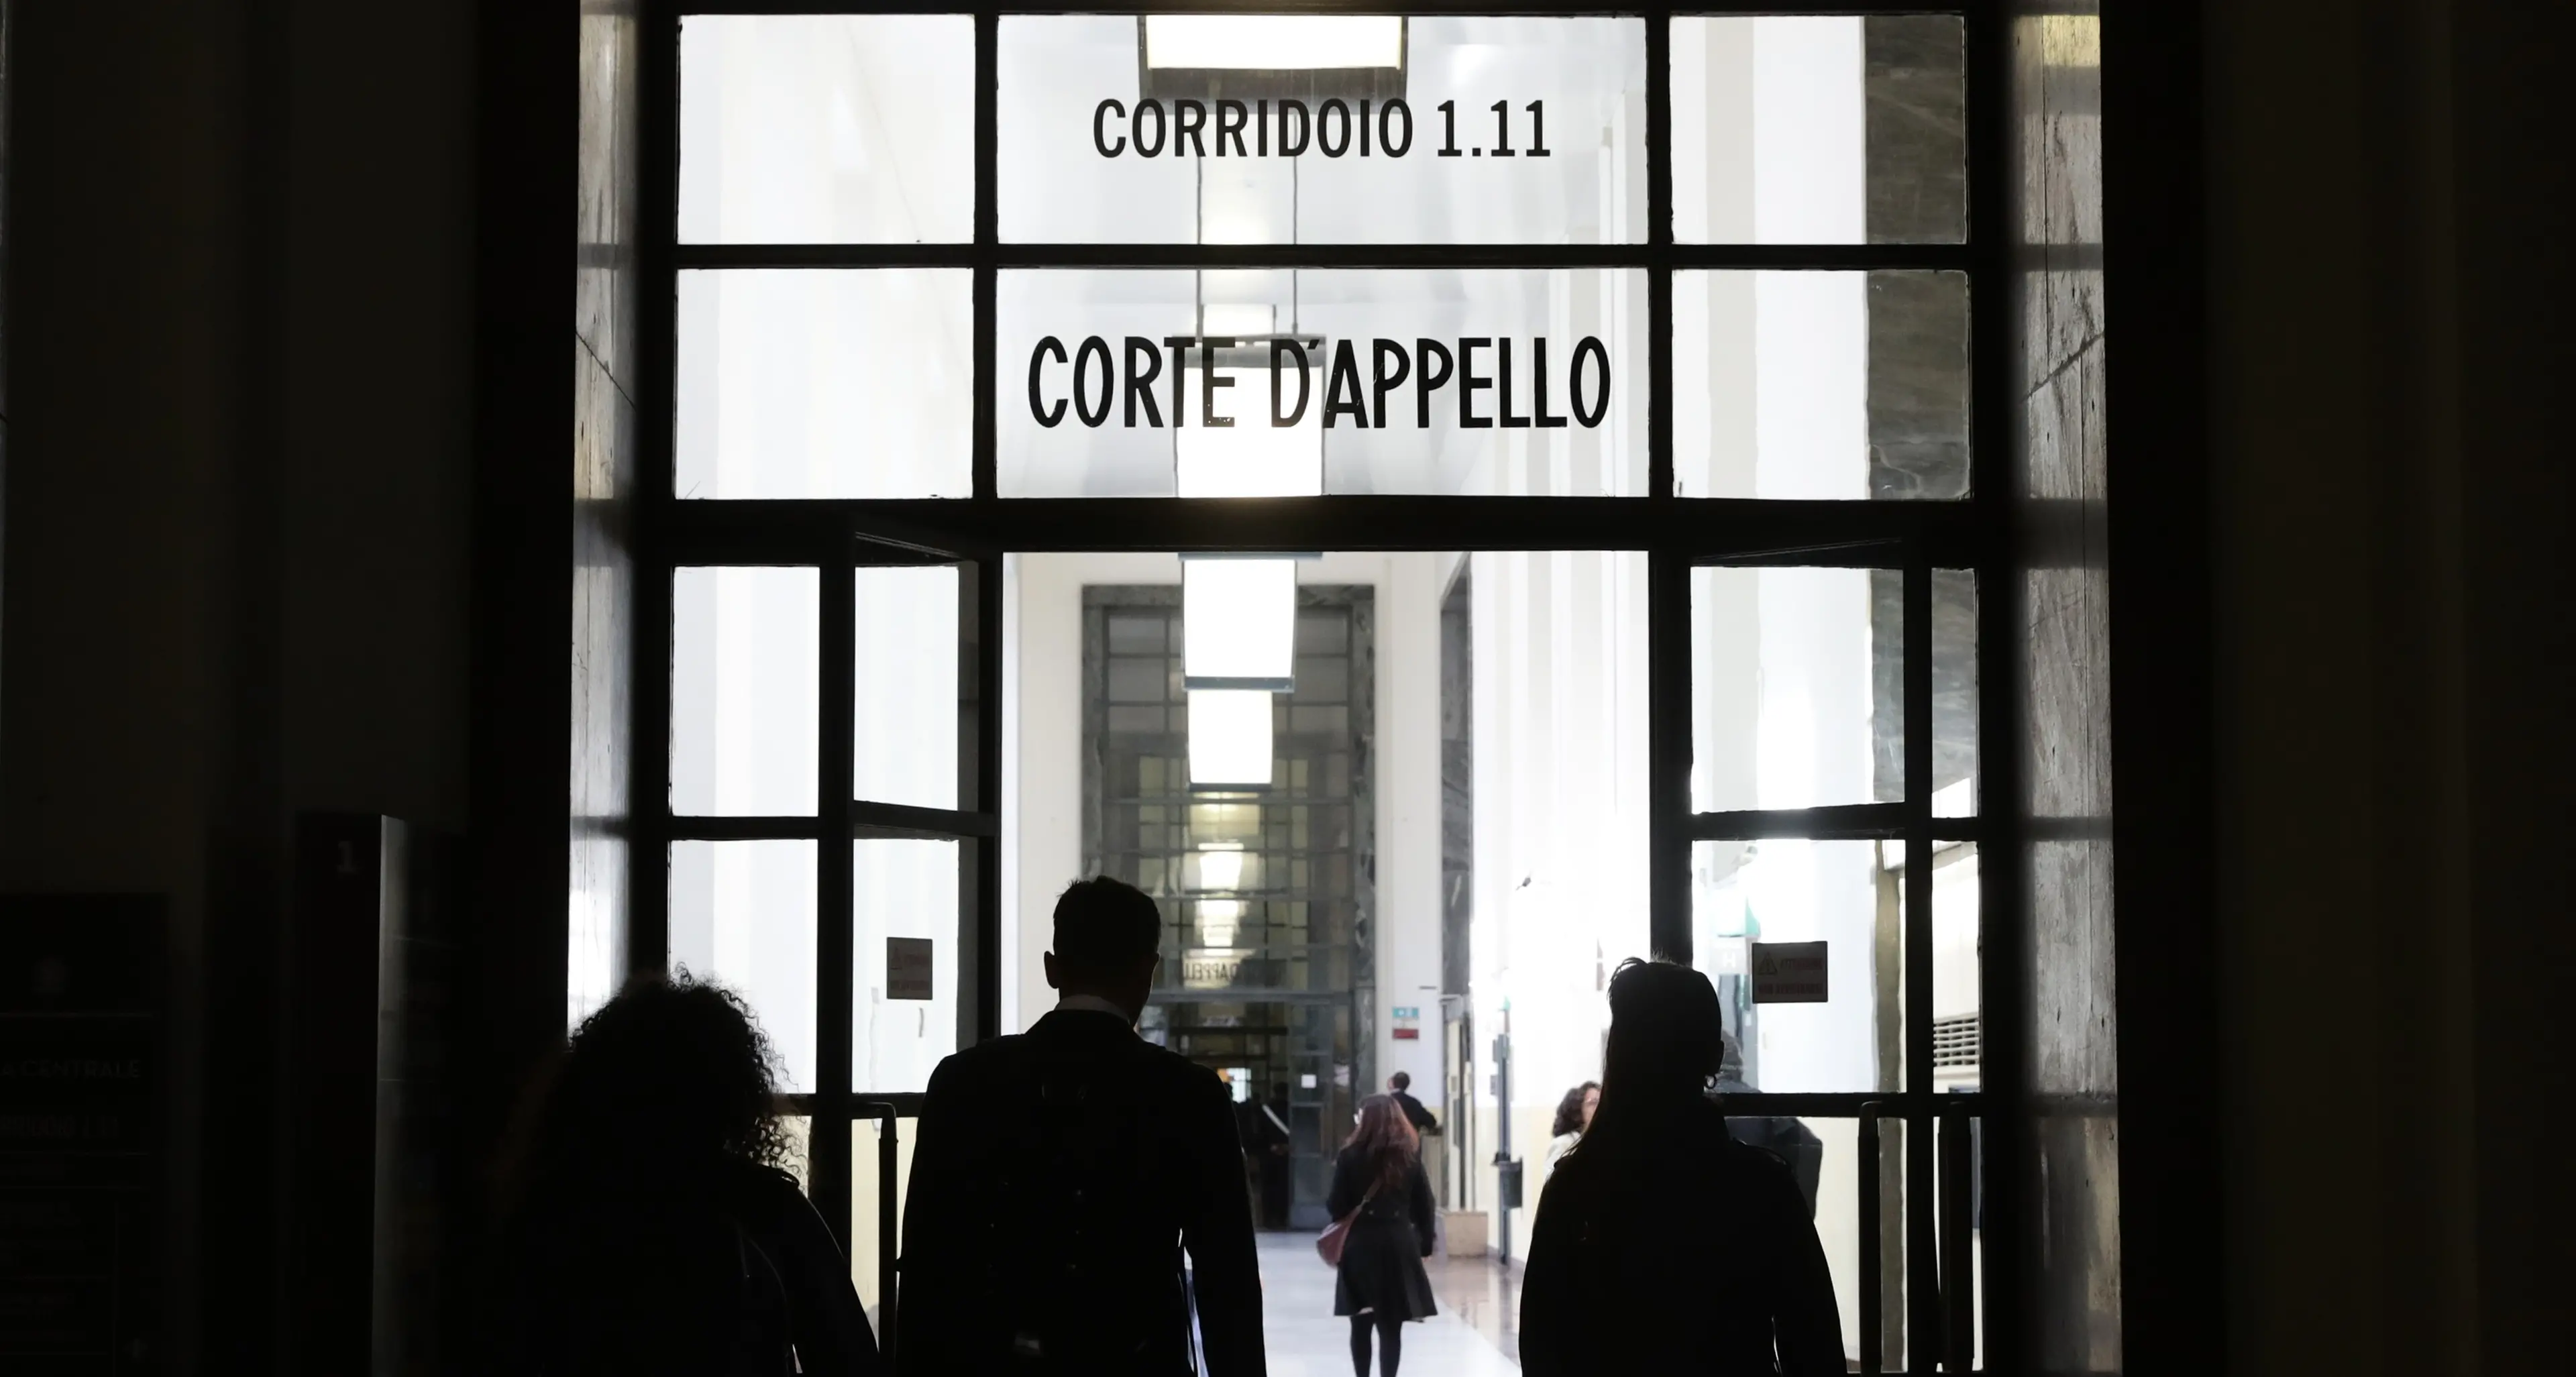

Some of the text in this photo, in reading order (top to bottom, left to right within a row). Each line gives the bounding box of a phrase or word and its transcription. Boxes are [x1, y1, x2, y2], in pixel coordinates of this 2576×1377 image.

[1093, 98, 1551, 158] CORRIDOIO 1.11
[1028, 335, 1611, 429] CORTE D'APPELLO
[20, 1058, 142, 1079] CENTRALE
